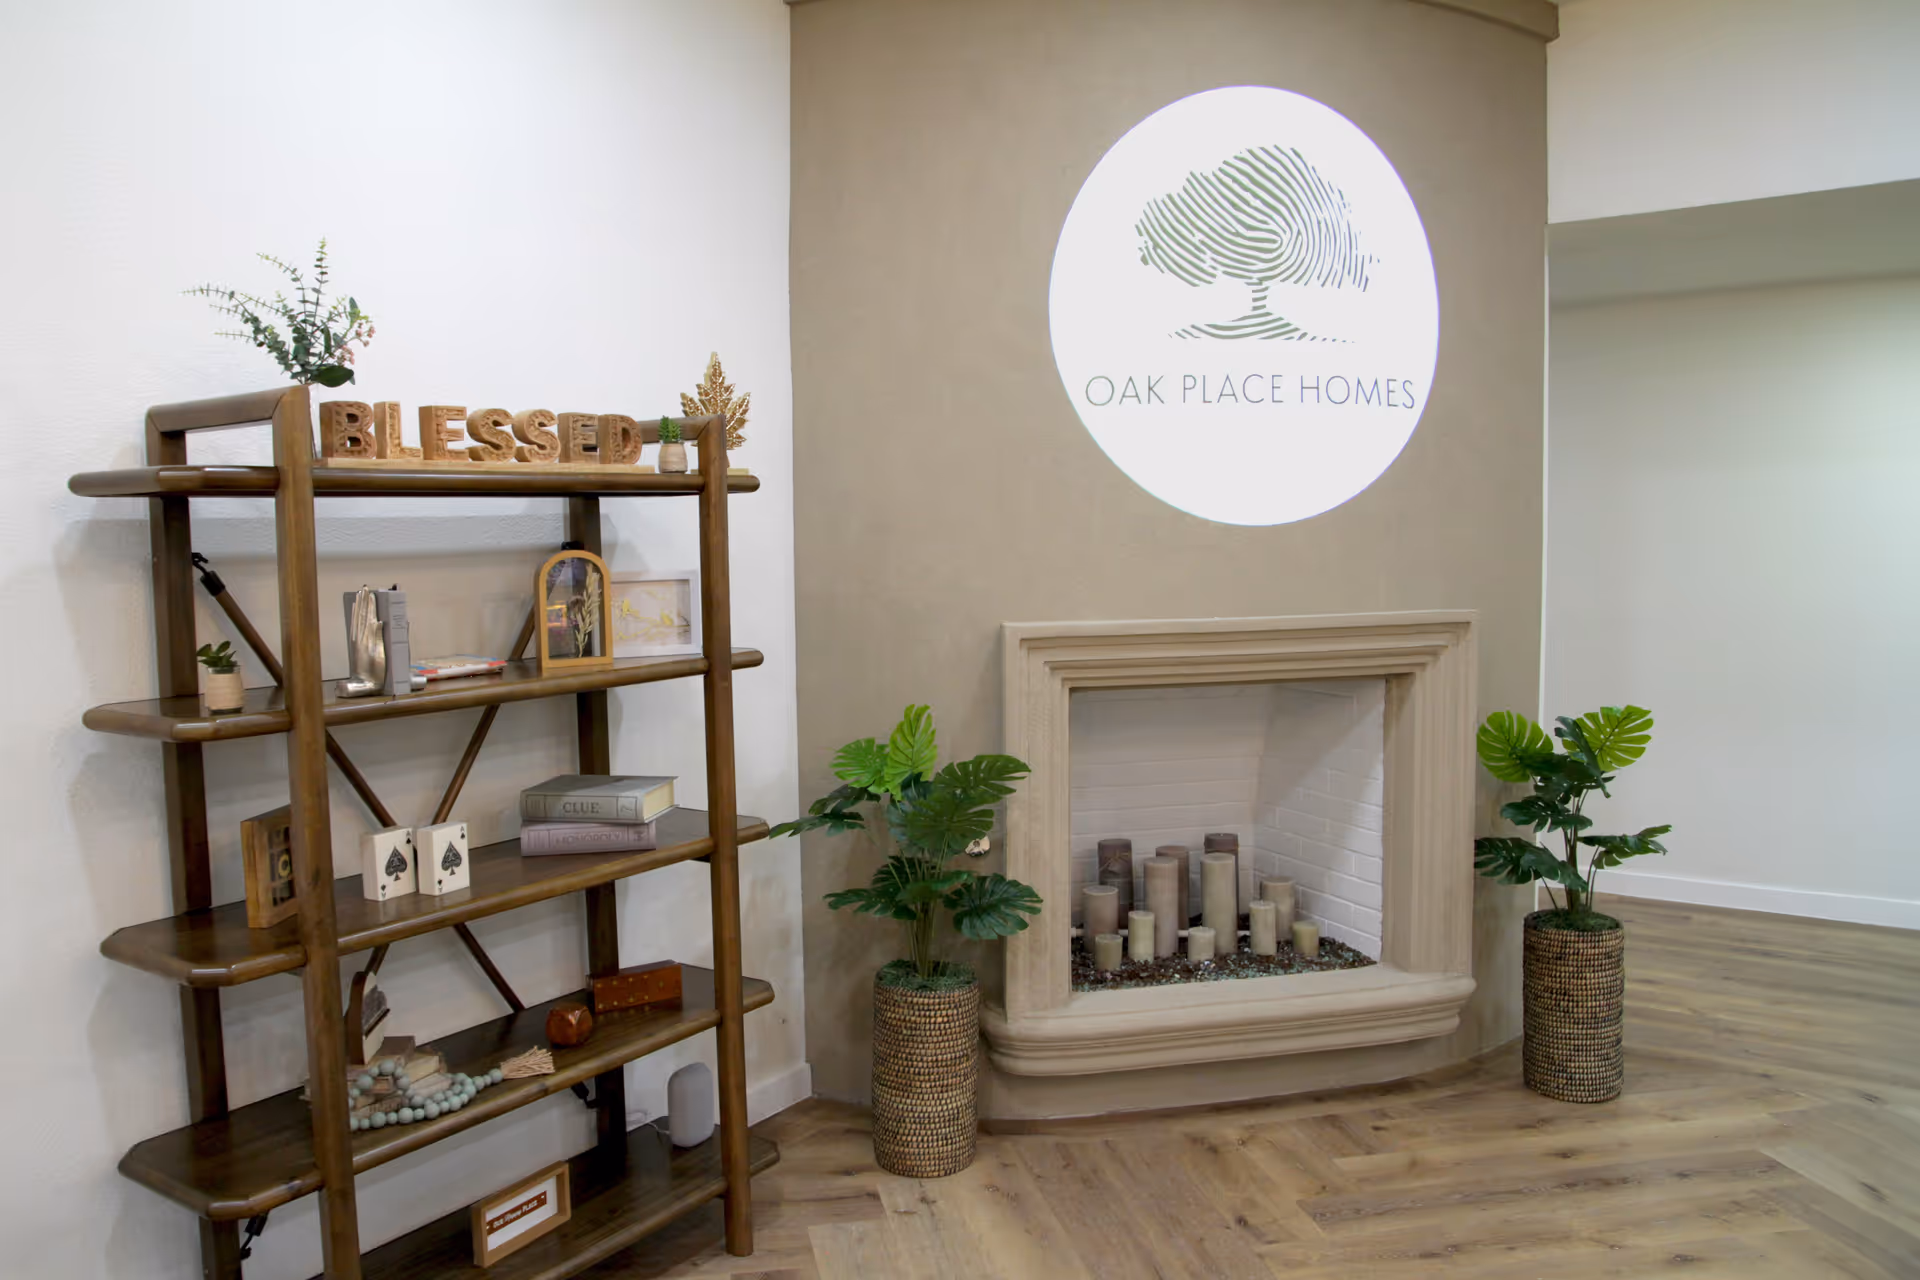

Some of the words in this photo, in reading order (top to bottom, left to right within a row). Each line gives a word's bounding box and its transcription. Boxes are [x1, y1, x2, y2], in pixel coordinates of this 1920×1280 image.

[1085, 374, 1165, 406] OAK
[1182, 373, 1285, 404] PLACE
[1300, 374, 1415, 409] HOMES
[319, 400, 643, 465] BLESSED
[562, 801, 599, 814] CLUE
